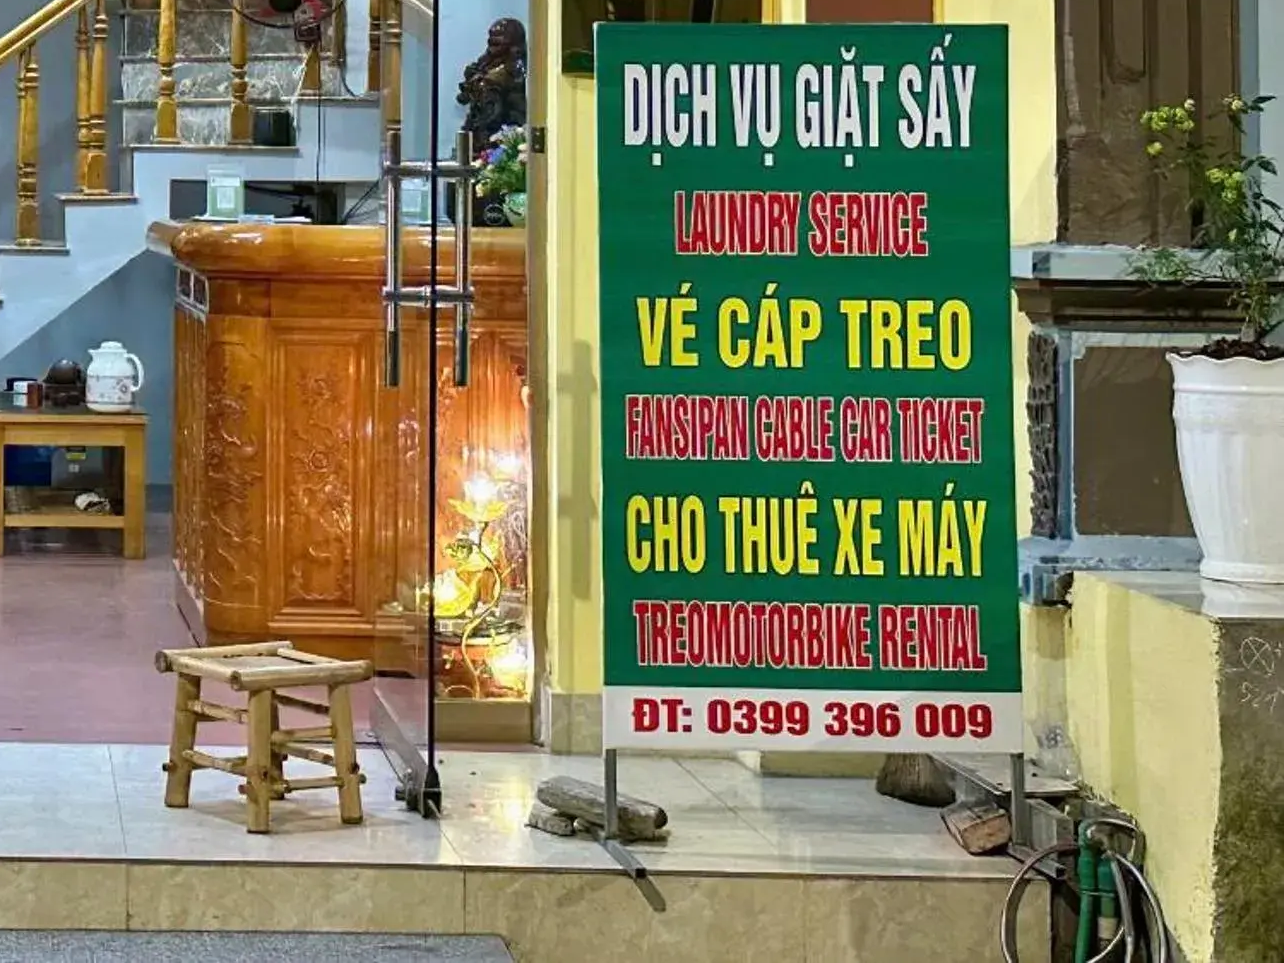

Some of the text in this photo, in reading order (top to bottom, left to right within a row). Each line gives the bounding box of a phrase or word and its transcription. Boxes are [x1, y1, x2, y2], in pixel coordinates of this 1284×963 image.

[624, 33, 976, 168] DỊCH VỤ GIẶT SẤY
[674, 190, 929, 257] LAUNDRY SERVICE
[637, 283, 971, 370] VÉ CÁP TREO
[625, 394, 984, 464] FANSIPAN CABLE CAR TICKET
[626, 481, 987, 577] CHO THUÊ XE MÁY
[633, 599, 988, 672] TREOMOTORBIKE RENTAL
[632, 698, 993, 739] ĐT: 0399 396 009
